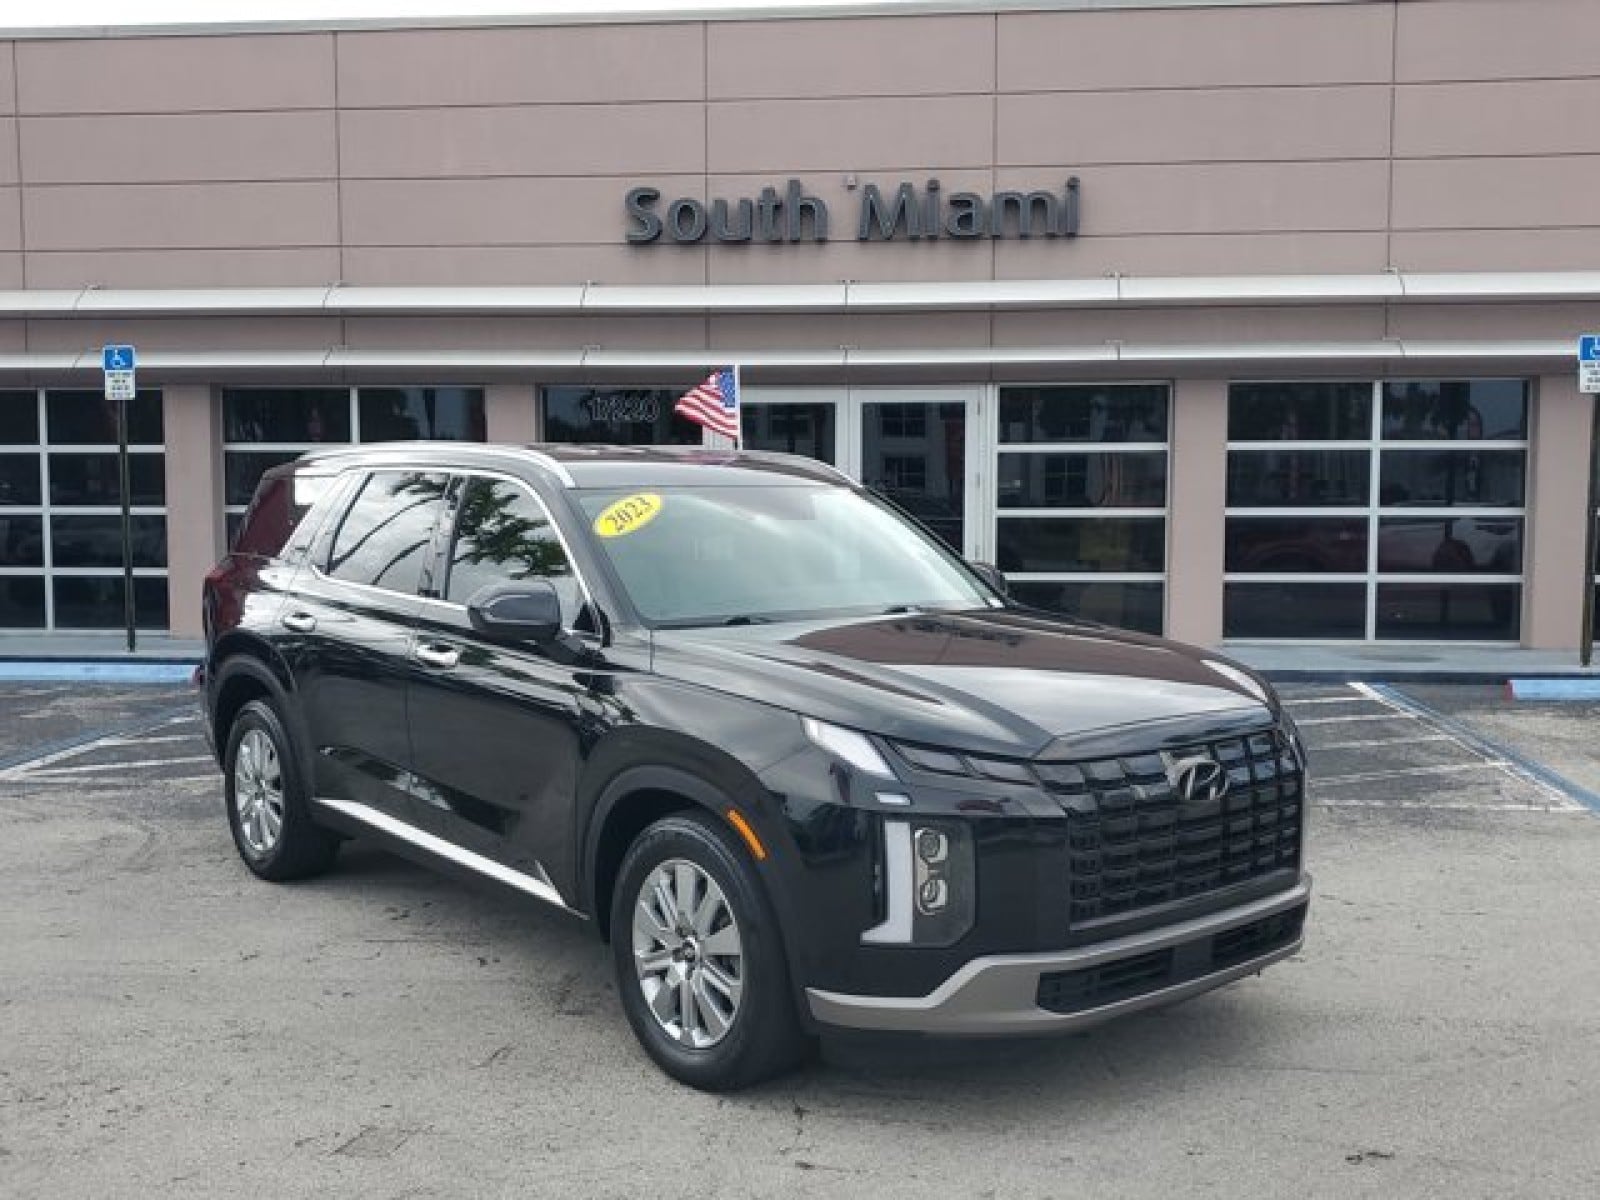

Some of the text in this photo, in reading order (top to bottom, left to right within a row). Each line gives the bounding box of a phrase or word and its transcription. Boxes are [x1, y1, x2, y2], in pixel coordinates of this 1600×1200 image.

[625, 177, 1081, 244] South Miami
[604, 496, 654, 533] 2023
